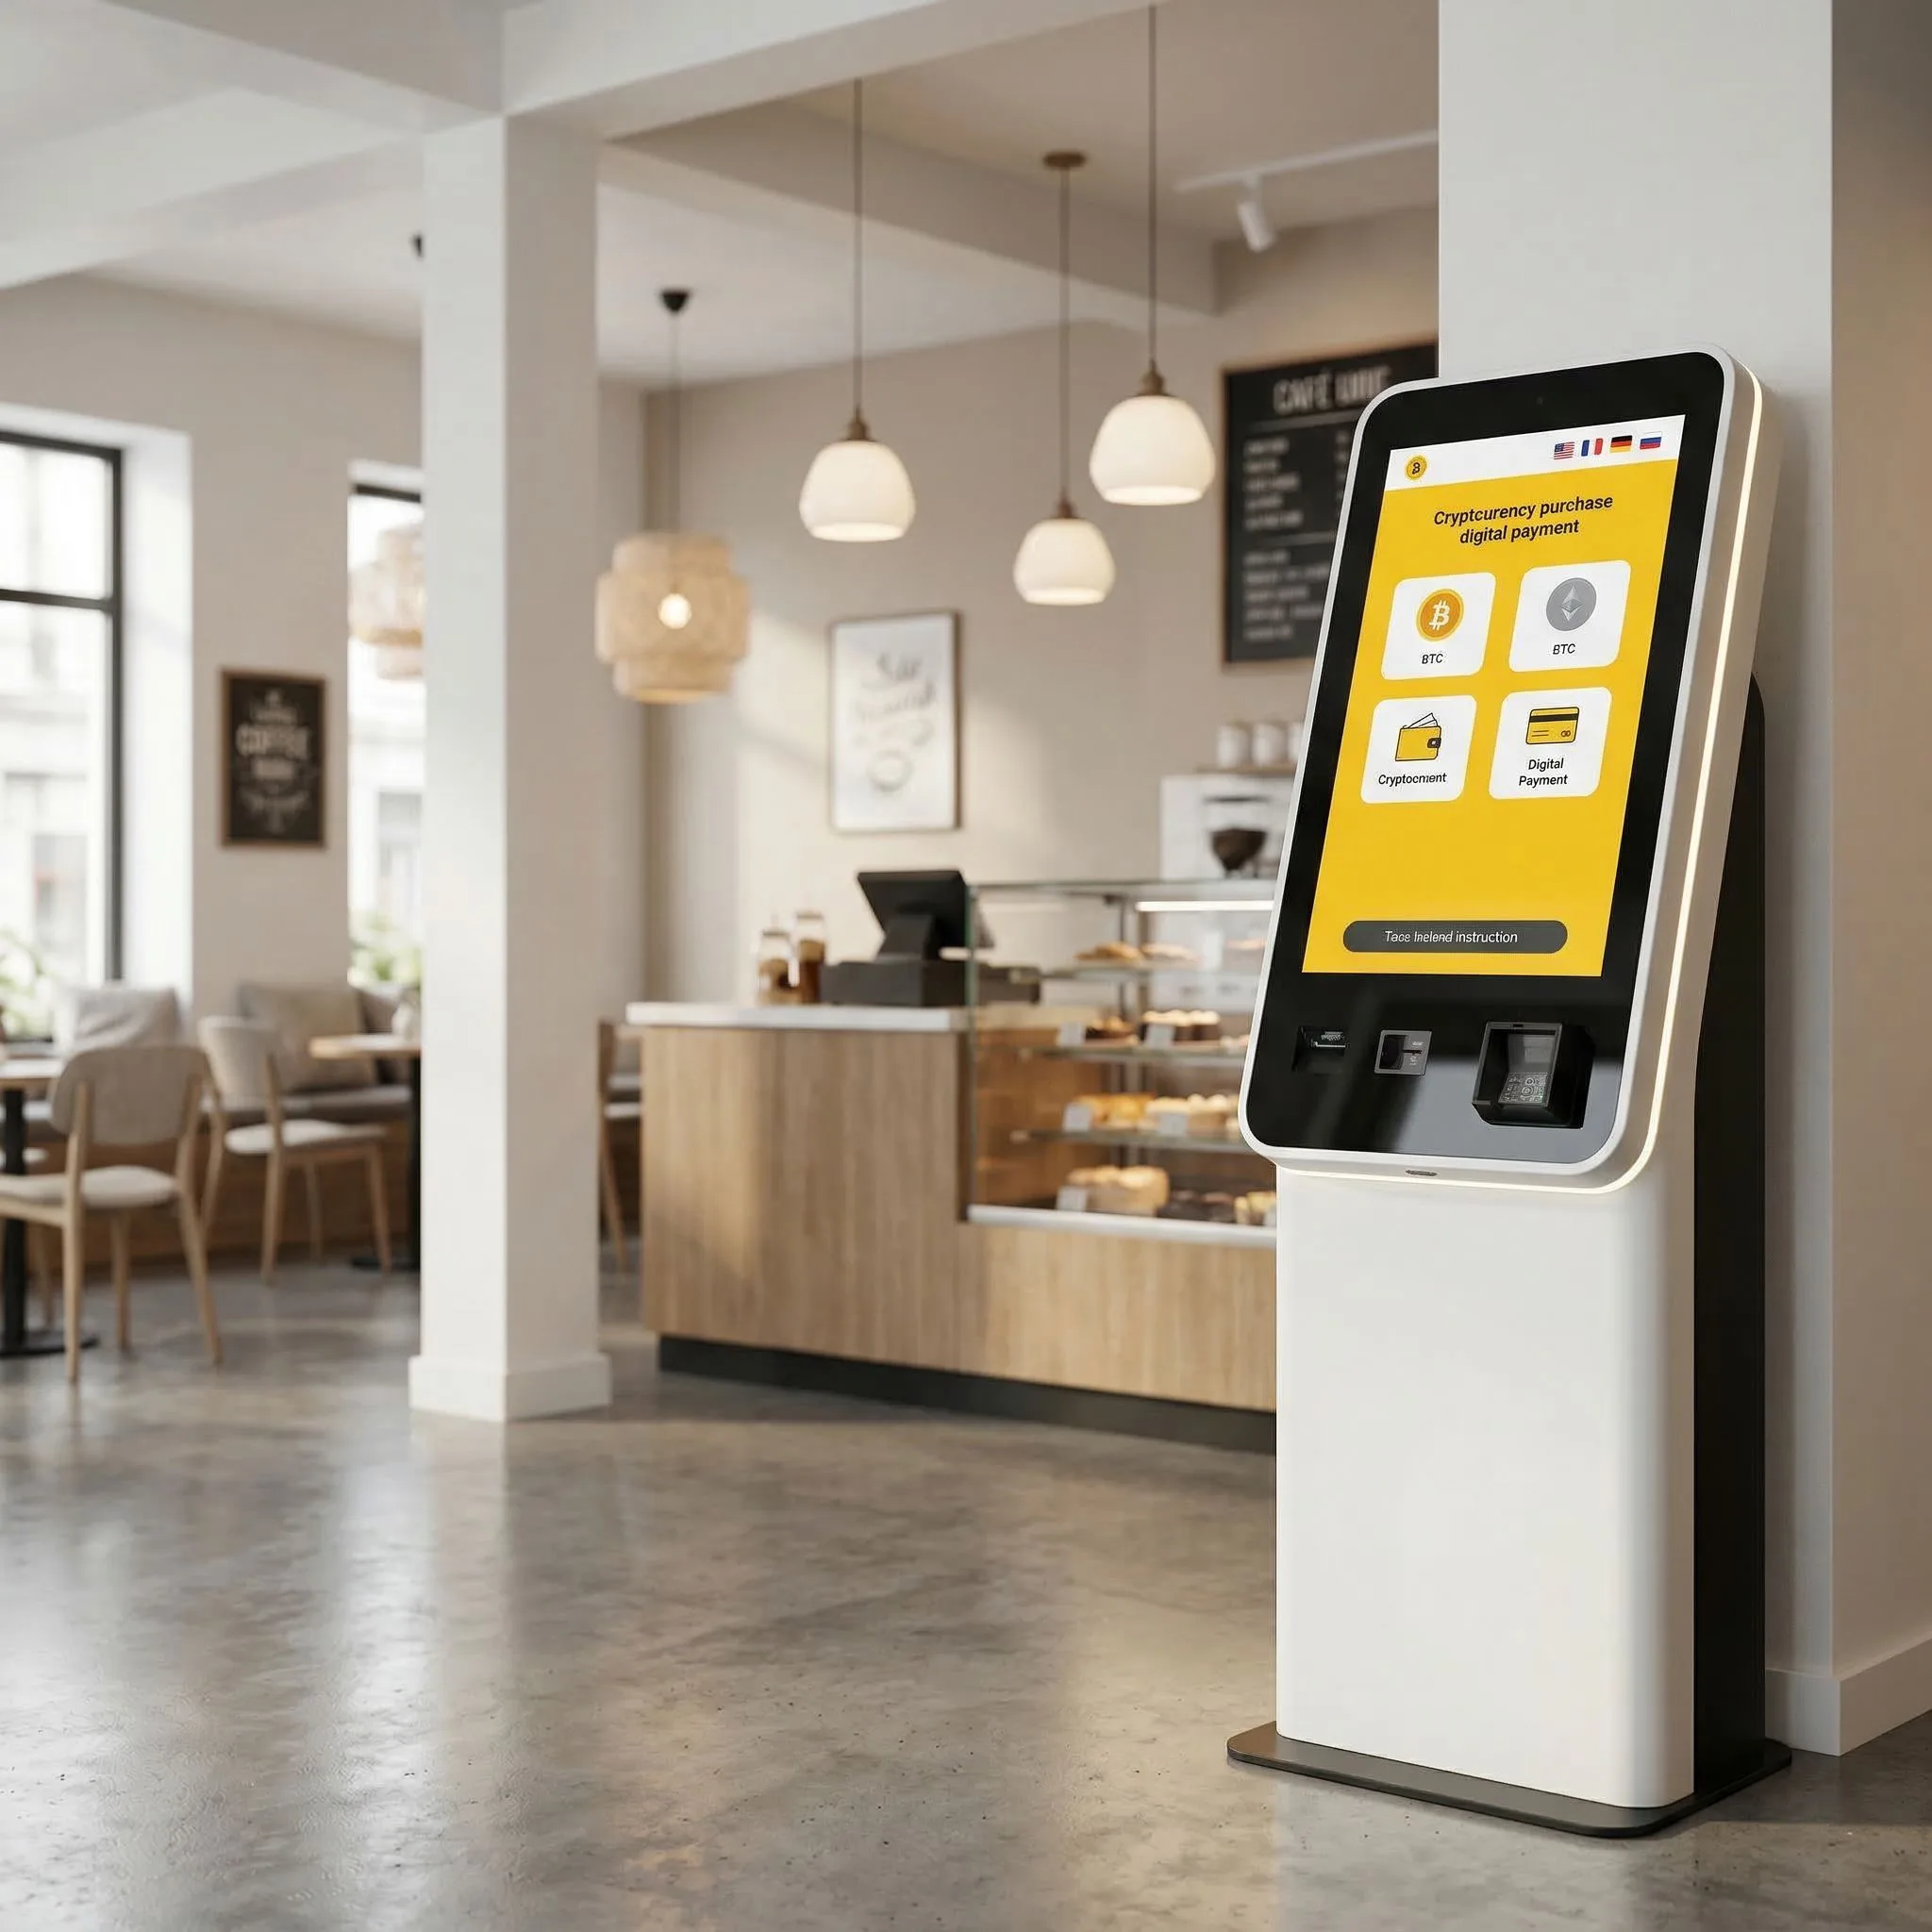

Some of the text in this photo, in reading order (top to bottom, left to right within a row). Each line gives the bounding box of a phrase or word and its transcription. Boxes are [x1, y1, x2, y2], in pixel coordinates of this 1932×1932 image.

[1434, 496, 1613, 527] Cryptcurency purchase
[1459, 519, 1580, 545] digital payment
[1553, 643, 1576, 656] BTC
[1422, 654, 1444, 664] BTC
[1528, 758, 1564, 772] Digital
[1519, 774, 1568, 789] Payment
[1456, 930, 1518, 943] instruction
